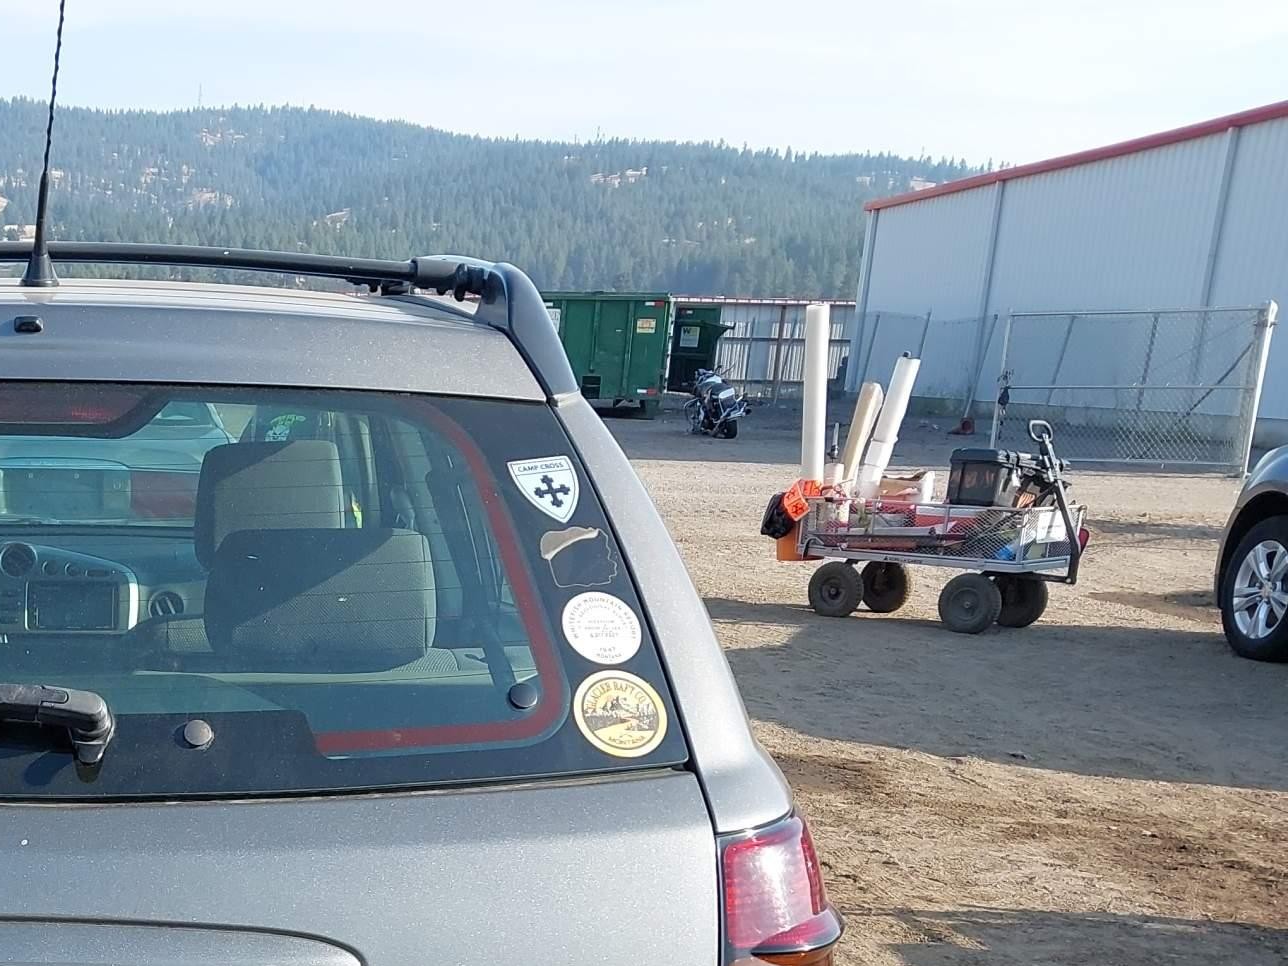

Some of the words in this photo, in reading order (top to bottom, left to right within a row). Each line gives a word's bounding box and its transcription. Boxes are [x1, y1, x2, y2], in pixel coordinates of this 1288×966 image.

[518, 464, 539, 473] CAMP
[540, 461, 565, 470] CROSS
[583, 597, 623, 611] MOUNTAIN
